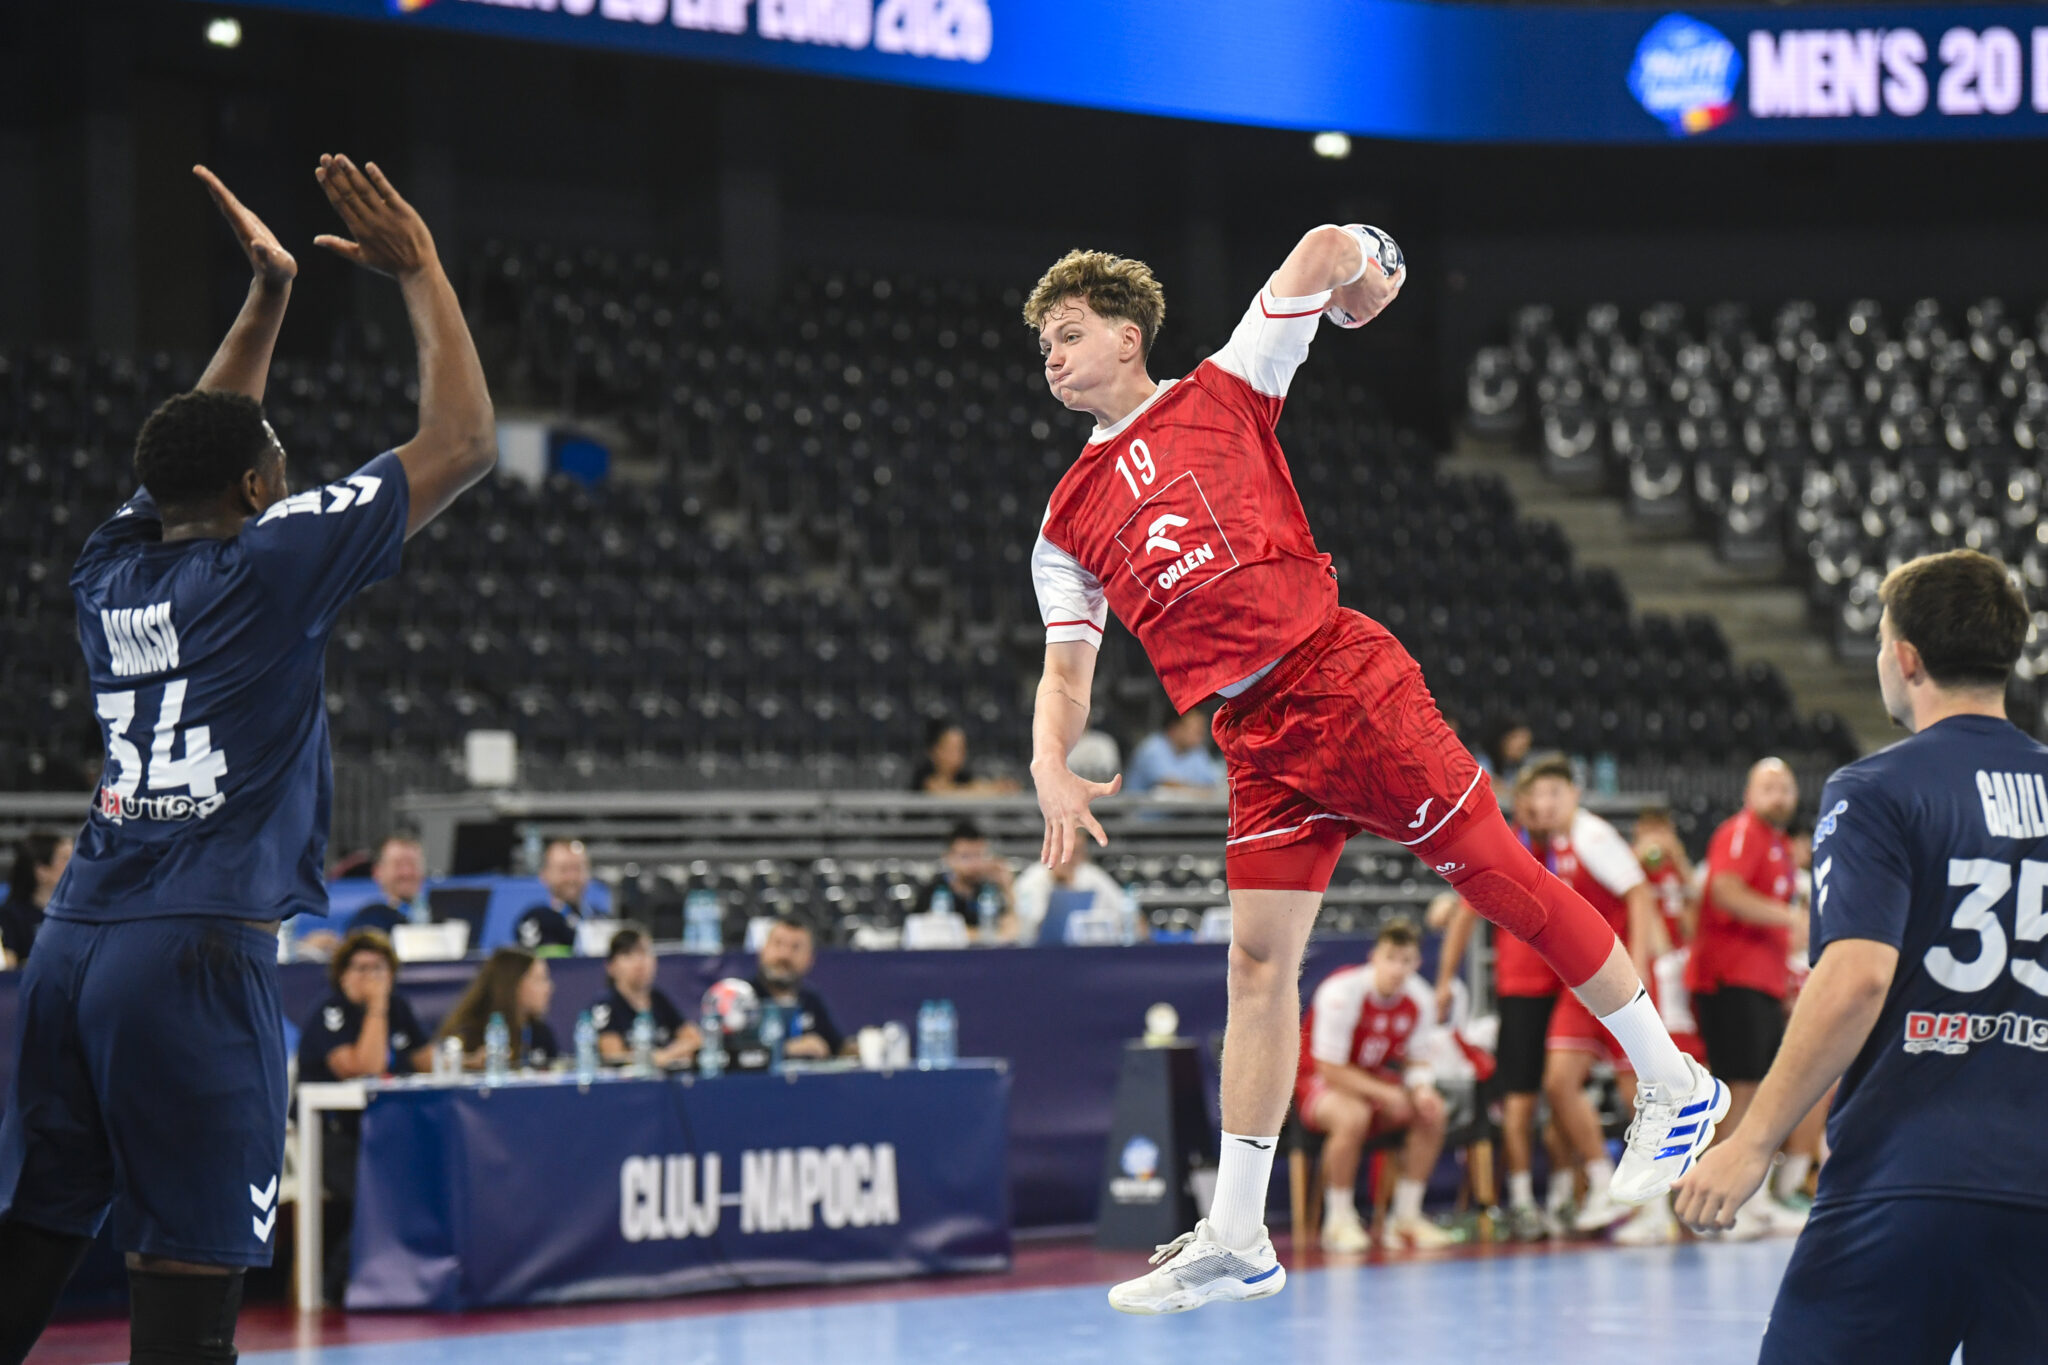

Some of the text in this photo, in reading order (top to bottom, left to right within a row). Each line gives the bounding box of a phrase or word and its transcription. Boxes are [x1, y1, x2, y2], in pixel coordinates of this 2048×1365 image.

[1937, 25, 2023, 116] 20
[1115, 438, 1156, 499] 19
[1157, 543, 1215, 589] ORLEN
[97, 679, 228, 798] 34
[620, 1143, 899, 1242] CLUJ-NAPOCA
